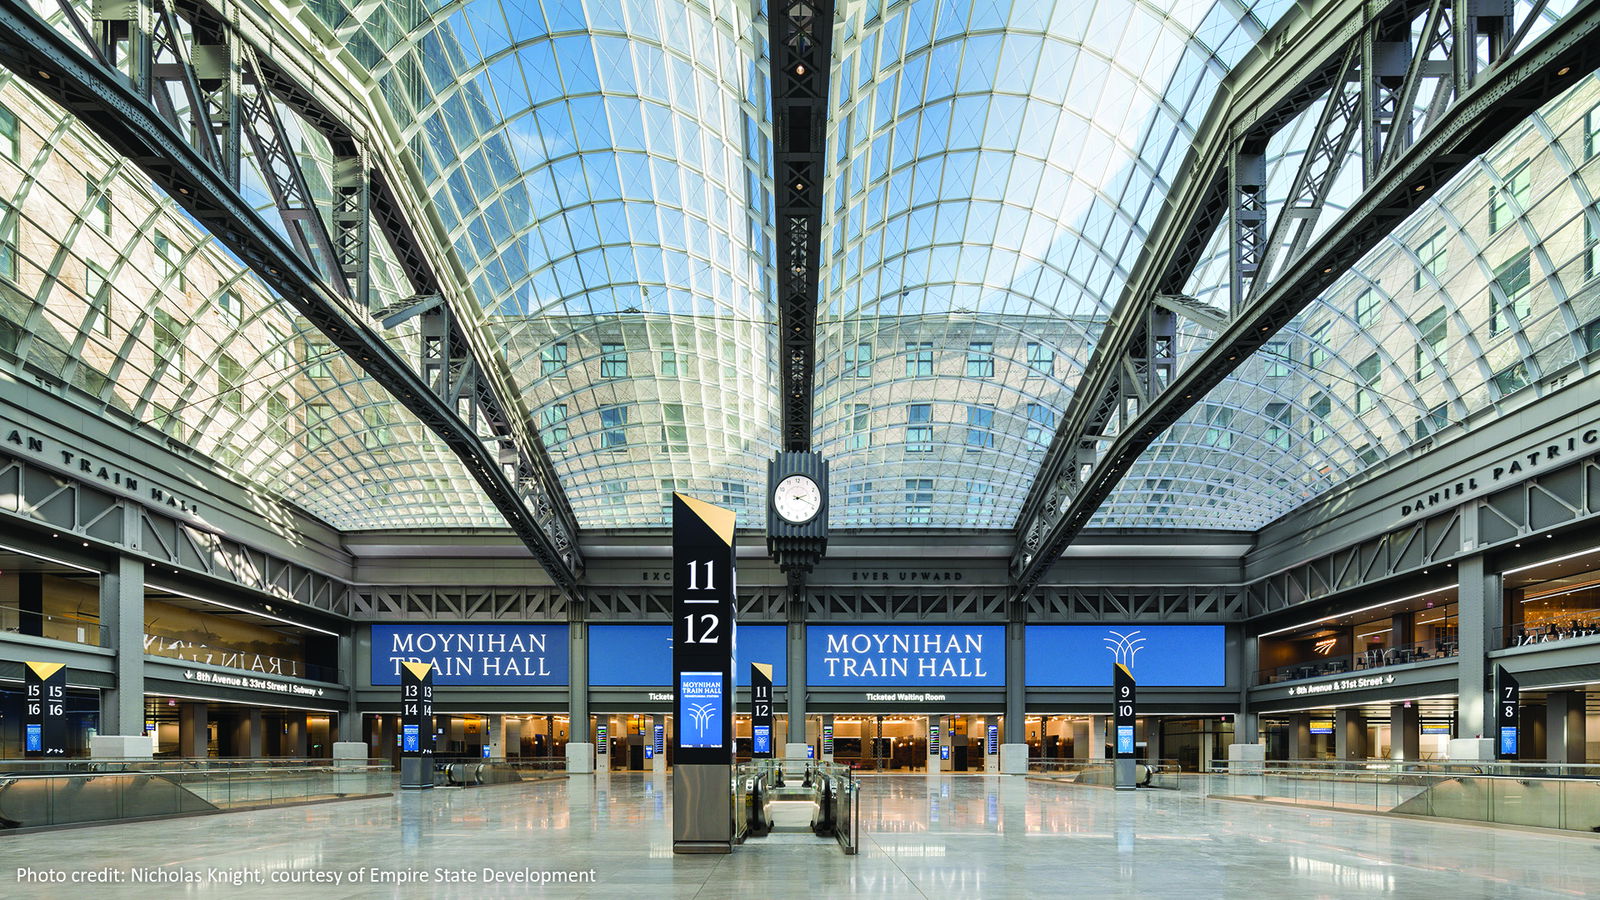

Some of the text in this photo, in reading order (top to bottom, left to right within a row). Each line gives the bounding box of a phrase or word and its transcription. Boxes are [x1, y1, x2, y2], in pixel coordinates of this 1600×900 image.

[6, 428, 44, 453] AN
[60, 449, 139, 491] TRAIN
[1401, 429, 1599, 516] DANIEL PATRIC
[687, 560, 716, 590] 11
[852, 571, 963, 581] EVER UPWARD
[684, 614, 720, 644] 12
[392, 633, 547, 654] MOYNIHAN
[826, 633, 983, 654] MOYNIHAN
[483, 657, 551, 677] HALL
[823, 657, 987, 677] TRAIN HALL
[196, 671, 211, 682] 8th
[212, 674, 240, 686] Avenue
[242, 678, 249, 687] &
[249, 679, 265, 689] 33rd
[266, 681, 287, 692] Street
[293, 685, 316, 697] Subway
[1296, 676, 1383, 695] 8th Avenue & 31st Street
[28, 685, 40, 696] 15
[49, 686, 63, 697] 15
[405, 685, 418, 697] 13
[424, 686, 432, 698] 13
[756, 686, 767, 697] 11
[1121, 686, 1130, 698] 9
[1505, 687, 1514, 699] 7
[866, 692, 946, 703] Ticketed Waiting Room
[28, 704, 40, 715] 16
[49, 705, 63, 716] 16
[405, 704, 418, 716] 14
[423, 705, 432, 716] 14
[755, 705, 769, 717] 12
[1119, 705, 1133, 717] 10
[1505, 706, 1514, 718] 8
